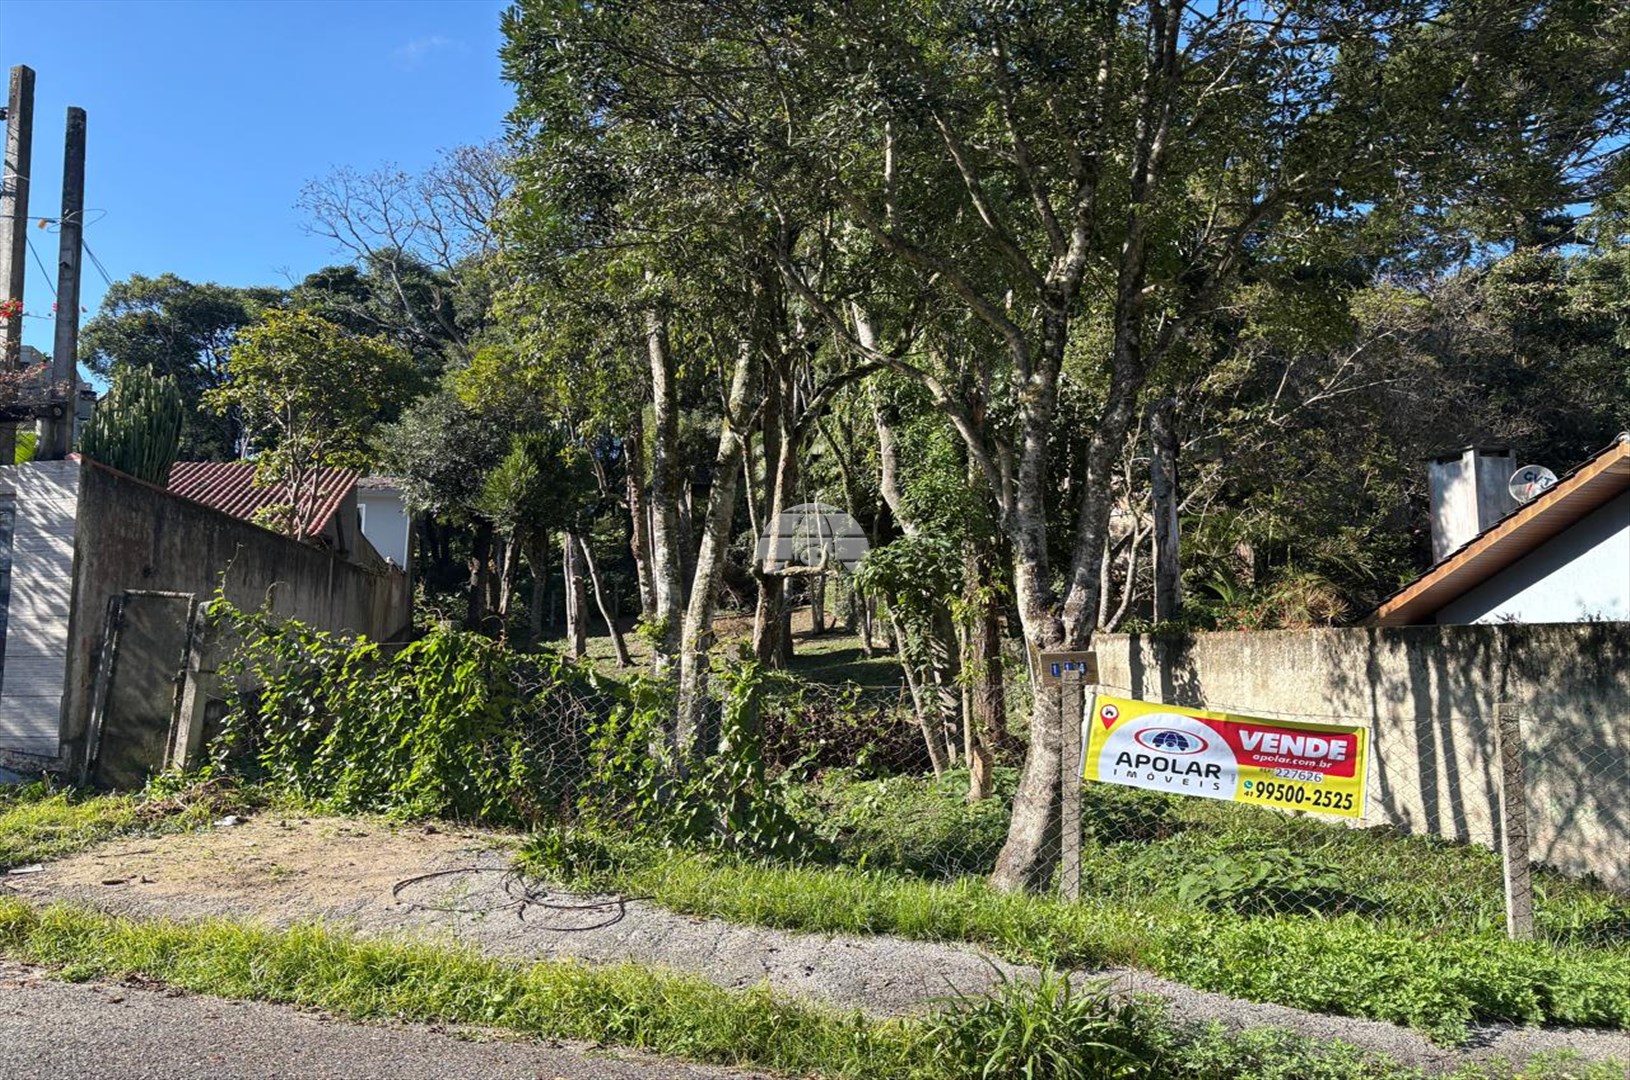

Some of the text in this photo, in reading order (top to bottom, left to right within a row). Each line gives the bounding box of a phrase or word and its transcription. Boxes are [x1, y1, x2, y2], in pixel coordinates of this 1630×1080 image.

[1524, 471, 1553, 486] GVT
[1239, 730, 1348, 760] VENDE
[1115, 752, 1222, 779] APOLAR
[1253, 754, 1332, 768] apolar.com.br
[1113, 768, 1220, 790] IMÓVEIS
[1275, 768, 1322, 782] 227626
[1256, 781, 1354, 810] 99500-2525
